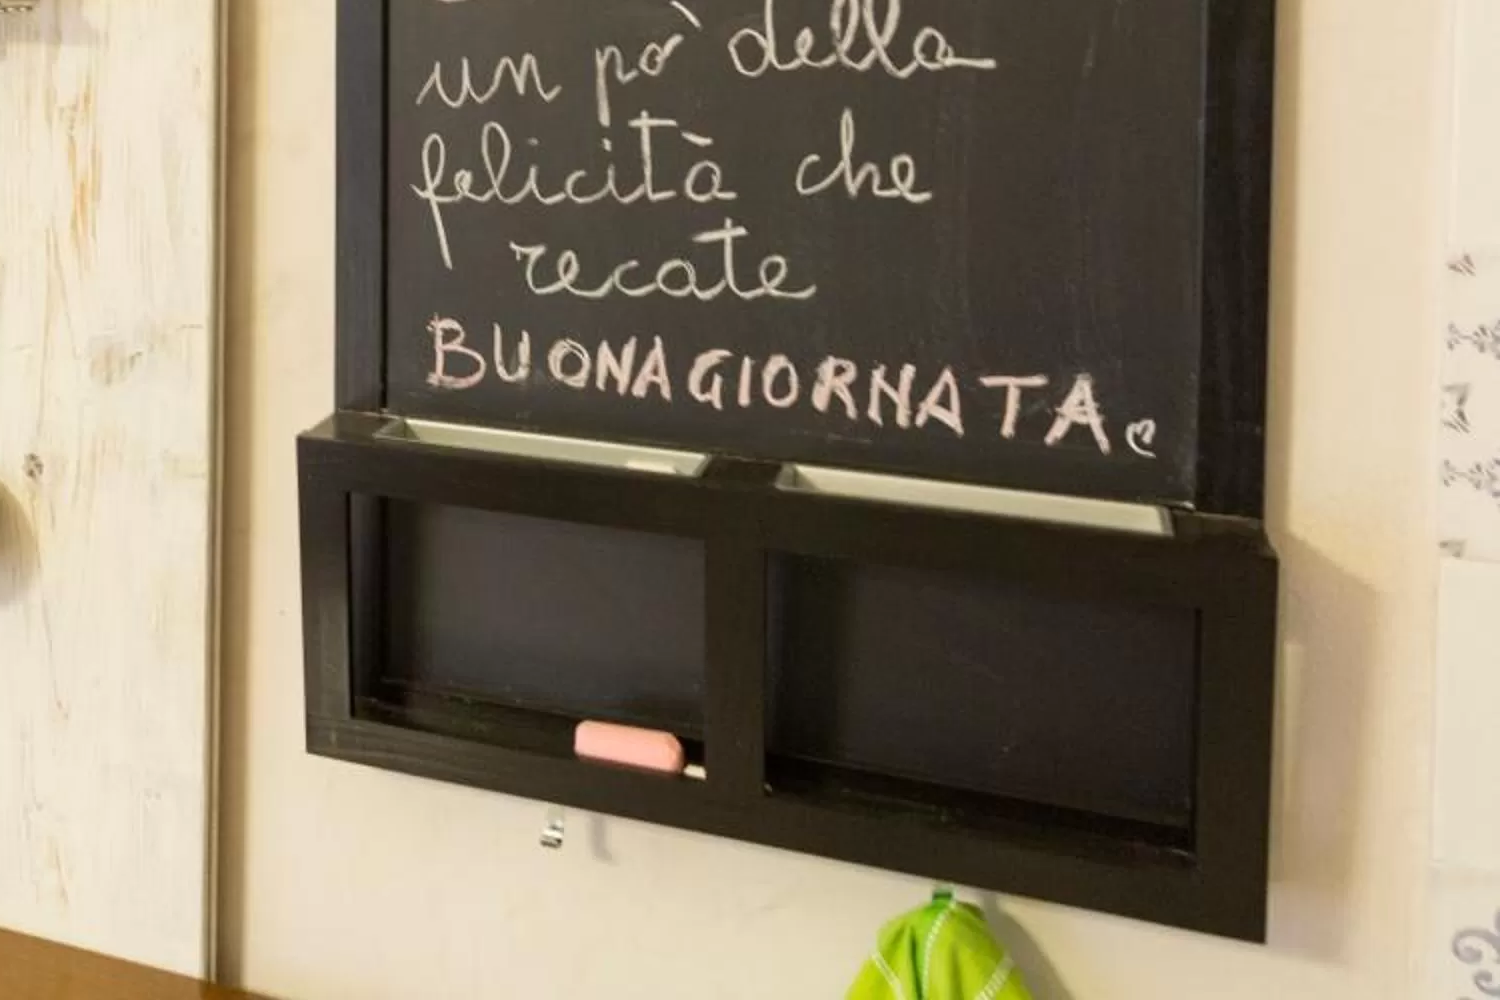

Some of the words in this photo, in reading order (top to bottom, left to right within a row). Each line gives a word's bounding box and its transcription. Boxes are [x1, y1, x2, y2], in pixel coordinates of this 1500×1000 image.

[416, 52, 562, 109] un
[795, 107, 933, 204] che
[509, 217, 818, 301] recate
